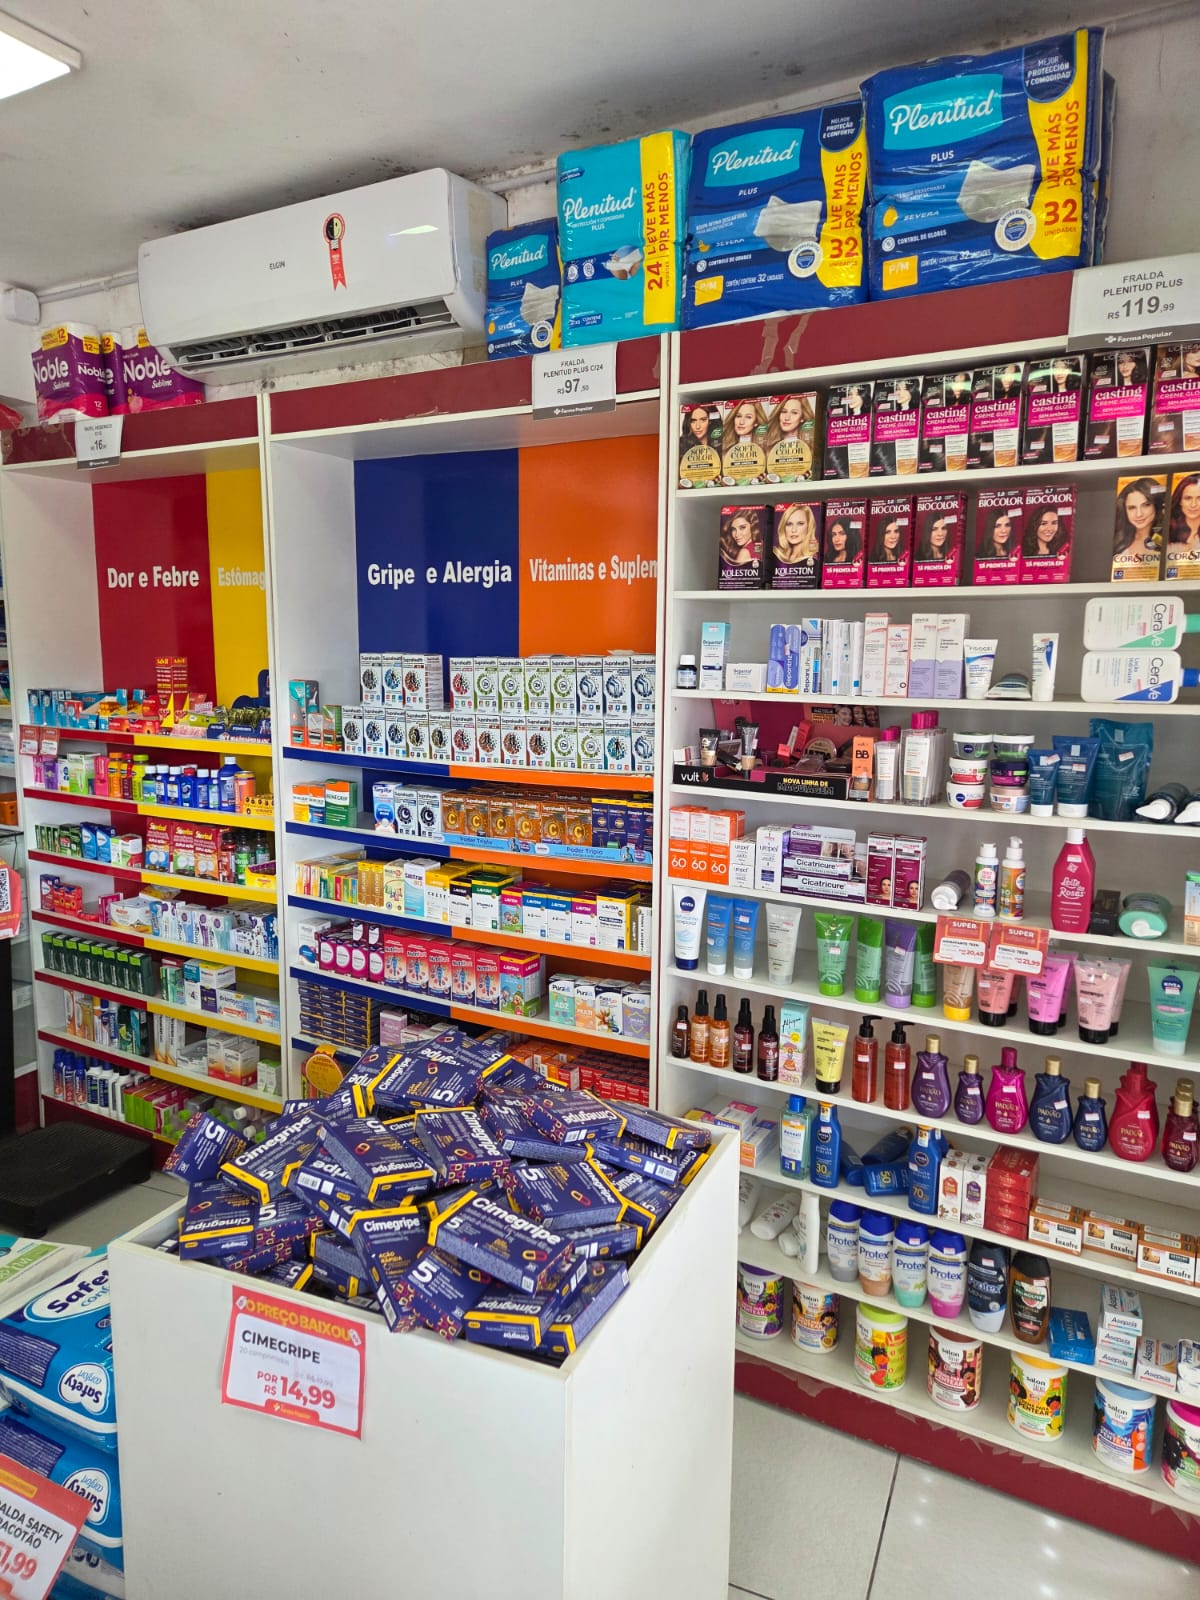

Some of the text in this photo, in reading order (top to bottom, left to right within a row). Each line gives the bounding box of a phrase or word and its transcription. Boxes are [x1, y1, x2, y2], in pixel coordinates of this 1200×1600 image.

[1038, 56, 1058, 66] MEJOR
[1027, 62, 1070, 78] PROTECCIÓN
[889, 89, 995, 135] Plenitud
[826, 121, 853, 132] PROTEÇÃO
[1044, 113, 1061, 151] MÁS
[1064, 100, 1080, 166] MENOS
[712, 140, 795, 175] Plenitud
[931, 150, 954, 162] PLUS
[832, 164, 847, 200] MAIS
[846, 151, 863, 206] MENOS
[643, 182, 655, 213] MÁS
[738, 187, 758, 196] PLUS
[562, 187, 635, 223] Plenitud
[658, 172, 669, 225] MENOS
[903, 209, 939, 221] SEVERA
[1044, 198, 1078, 226] 32
[830, 235, 859, 259] 32
[269, 260, 286, 270] ELGIN
[491, 245, 545, 272] Plenitud
[646, 260, 663, 291] 24
[757, 272, 767, 283] 32
[1122, 270, 1165, 284] FRALDA
[1103, 278, 1184, 298] PLENITUD PLUS
[1107, 311, 1120, 320] R$
[57, 328, 66, 340] 12
[85, 343, 94, 351] 12
[560, 358, 585, 367] FRALDA
[34, 357, 69, 385] Noble
[123, 355, 171, 384] Noble
[544, 368, 572, 378] PLENITUD
[573, 366, 589, 374] PLUS
[1094, 385, 1143, 401] casting
[974, 399, 1017, 414] casting
[1031, 392, 1077, 408] casting
[877, 411, 917, 424] casting
[926, 406, 967, 420] casting
[830, 416, 868, 428] casting
[691, 447, 711, 456] SOFT
[734, 444, 755, 452] SOFT
[775, 447, 804, 456] COLOR
[779, 441, 801, 449] SOFT
[687, 454, 713, 462] COLOR
[730, 450, 758, 459] COLOR
[978, 496, 1024, 508] BIOCOLOR
[1025, 494, 1072, 504] BIOCOLOR
[826, 506, 866, 516] BIOCOLOR
[871, 504, 911, 514] BIOCOLOR
[917, 501, 959, 511] BIOCOLOR
[367, 559, 512, 590] Gripe e Alergia
[529, 557, 607, 582] Vitaminas e
[721, 568, 759, 579] KOLESTON
[775, 566, 814, 577] KOLESTON
[107, 565, 199, 589] Dor e Febre
[1152, 603, 1167, 647] CeraVe
[1148, 657, 1164, 700] CeraVe
[856, 750, 870, 759] BB
[680, 771, 700, 784] vult
[783, 777, 800, 785] NOVA
[801, 779, 819, 787] LINHA
[792, 830, 822, 839] Cicatricure
[566, 846, 584, 854] Poder
[671, 858, 687, 868] 60
[691, 860, 707, 871] 60
[711, 863, 727, 874] 60
[796, 859, 836, 870] Cicatricure
[801, 878, 845, 890] Cicatricure
[1061, 877, 1081, 887] Leite
[1057, 887, 1085, 898] Rosas
[952, 921, 977, 929] SUPER
[1008, 928, 1035, 938] SUPER
[1022, 958, 1041, 967] 21,99
[379, 1056, 412, 1091] Cimegripe
[432, 1089, 453, 1102] 5
[562, 1109, 618, 1125] Cimegripe
[205, 1120, 225, 1143] 5
[366, 1119, 386, 1134] 5
[461, 1111, 501, 1157] Cimegripe
[235, 1116, 313, 1166] Cimegripe
[259, 1168, 275, 1180] 5
[371, 1161, 423, 1174] Cimegripe
[815, 1163, 827, 1174] 30
[521, 1168, 545, 1181] 5
[880, 1170, 892, 1185] 50
[578, 1161, 616, 1204] Cimegripe
[913, 1185, 924, 1199] 70
[258, 1204, 277, 1221] 5
[186, 1217, 251, 1232] Cimegripe
[363, 1216, 421, 1233] Cimegripe
[445, 1216, 464, 1229] 5
[472, 1196, 563, 1246] Cimegripe
[829, 1233, 858, 1247] Protex
[1055, 1238, 1079, 1250] Enxofre
[859, 1246, 890, 1260] Protex
[1110, 1242, 1135, 1256] Enxofre
[380, 1255, 403, 1265] RÁPIDA
[896, 1258, 927, 1271] Protex
[412, 1259, 438, 1283] 5
[930, 1267, 962, 1281] Protex
[1166, 1267, 1192, 1280] Enxofre
[802, 1294, 819, 1303] salon
[477, 1300, 542, 1315] Cimegripe
[245, 1299, 352, 1342] O PREÇO BAIXOU
[241, 1329, 321, 1364] CIMEGRIPE
[941, 1348, 960, 1358] salon
[257, 1370, 278, 1384] POR
[1026, 1376, 1046, 1386] salon
[64, 1373, 103, 1404] Safety
[264, 1375, 336, 1409] R$ 14,99
[1019, 1402, 1049, 1416] PENTEAR
[1107, 1402, 1128, 1416] salon
[26, 1517, 63, 1544] SAFETY
